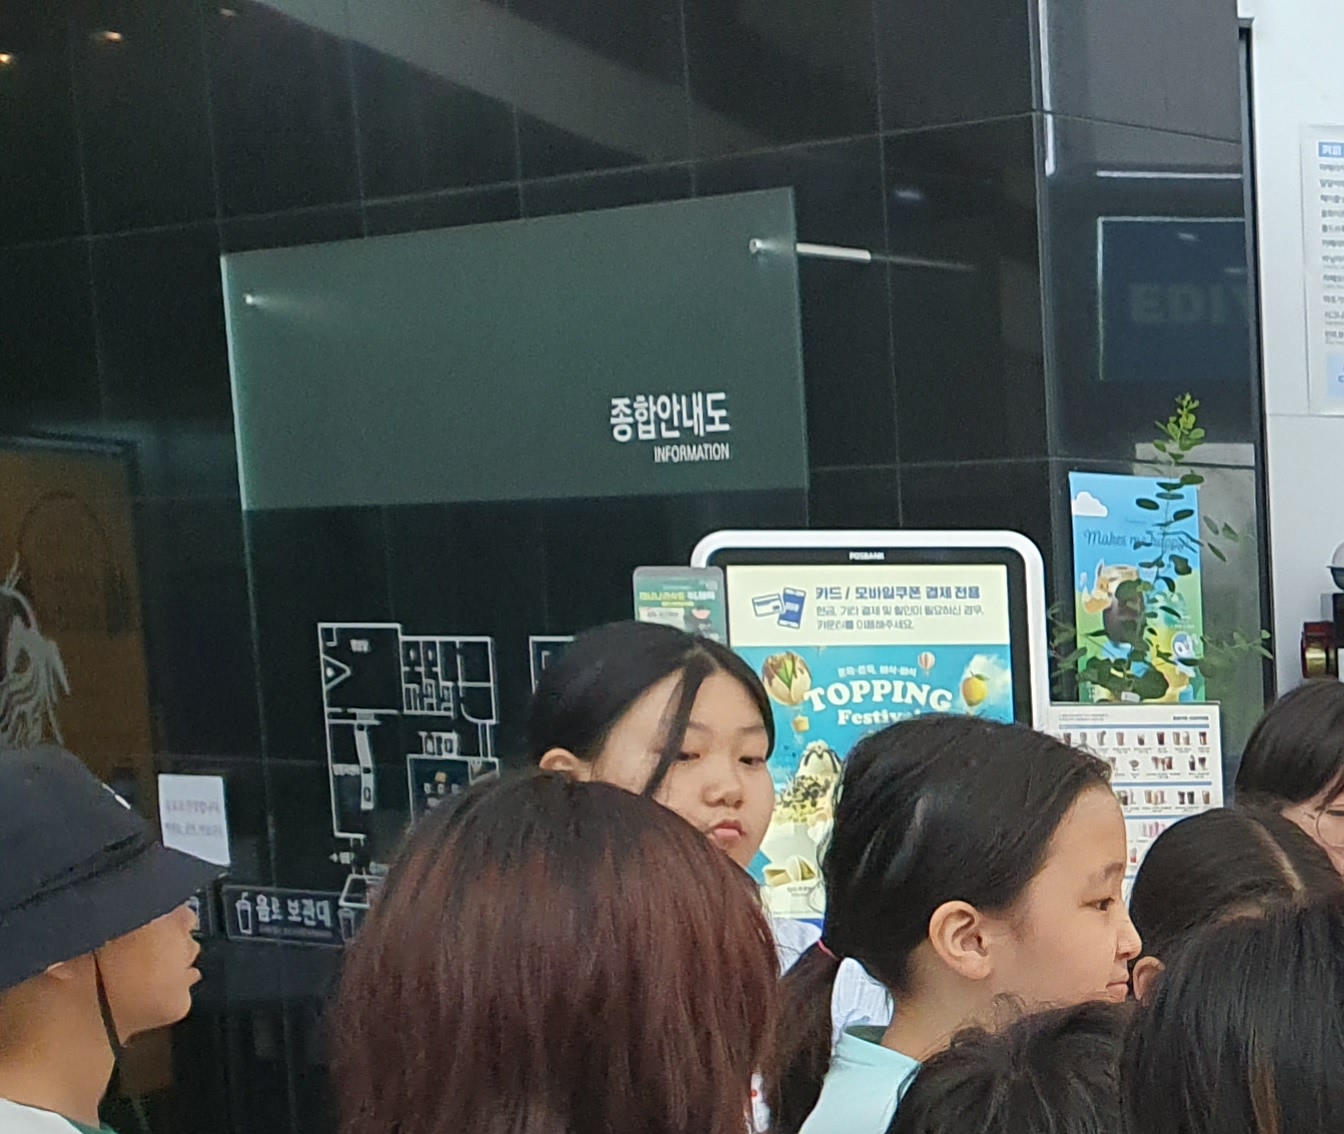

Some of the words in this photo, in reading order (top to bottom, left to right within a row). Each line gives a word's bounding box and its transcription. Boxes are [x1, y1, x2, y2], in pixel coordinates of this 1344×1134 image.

[610, 391, 730, 442] 종합안내도
[654, 443, 729, 463] INFORMATION
[849, 552, 885, 560] POSBANK
[816, 586, 842, 600] 카드
[855, 586, 921, 600] 모바일쿠폰
[926, 586, 951, 600] 결제
[955, 586, 980, 600] 전용
[804, 680, 953, 712] TOPPING
[838, 708, 921, 726] Festiv
[256, 894, 282, 922] 음료
[287, 898, 331, 927] 보관대
